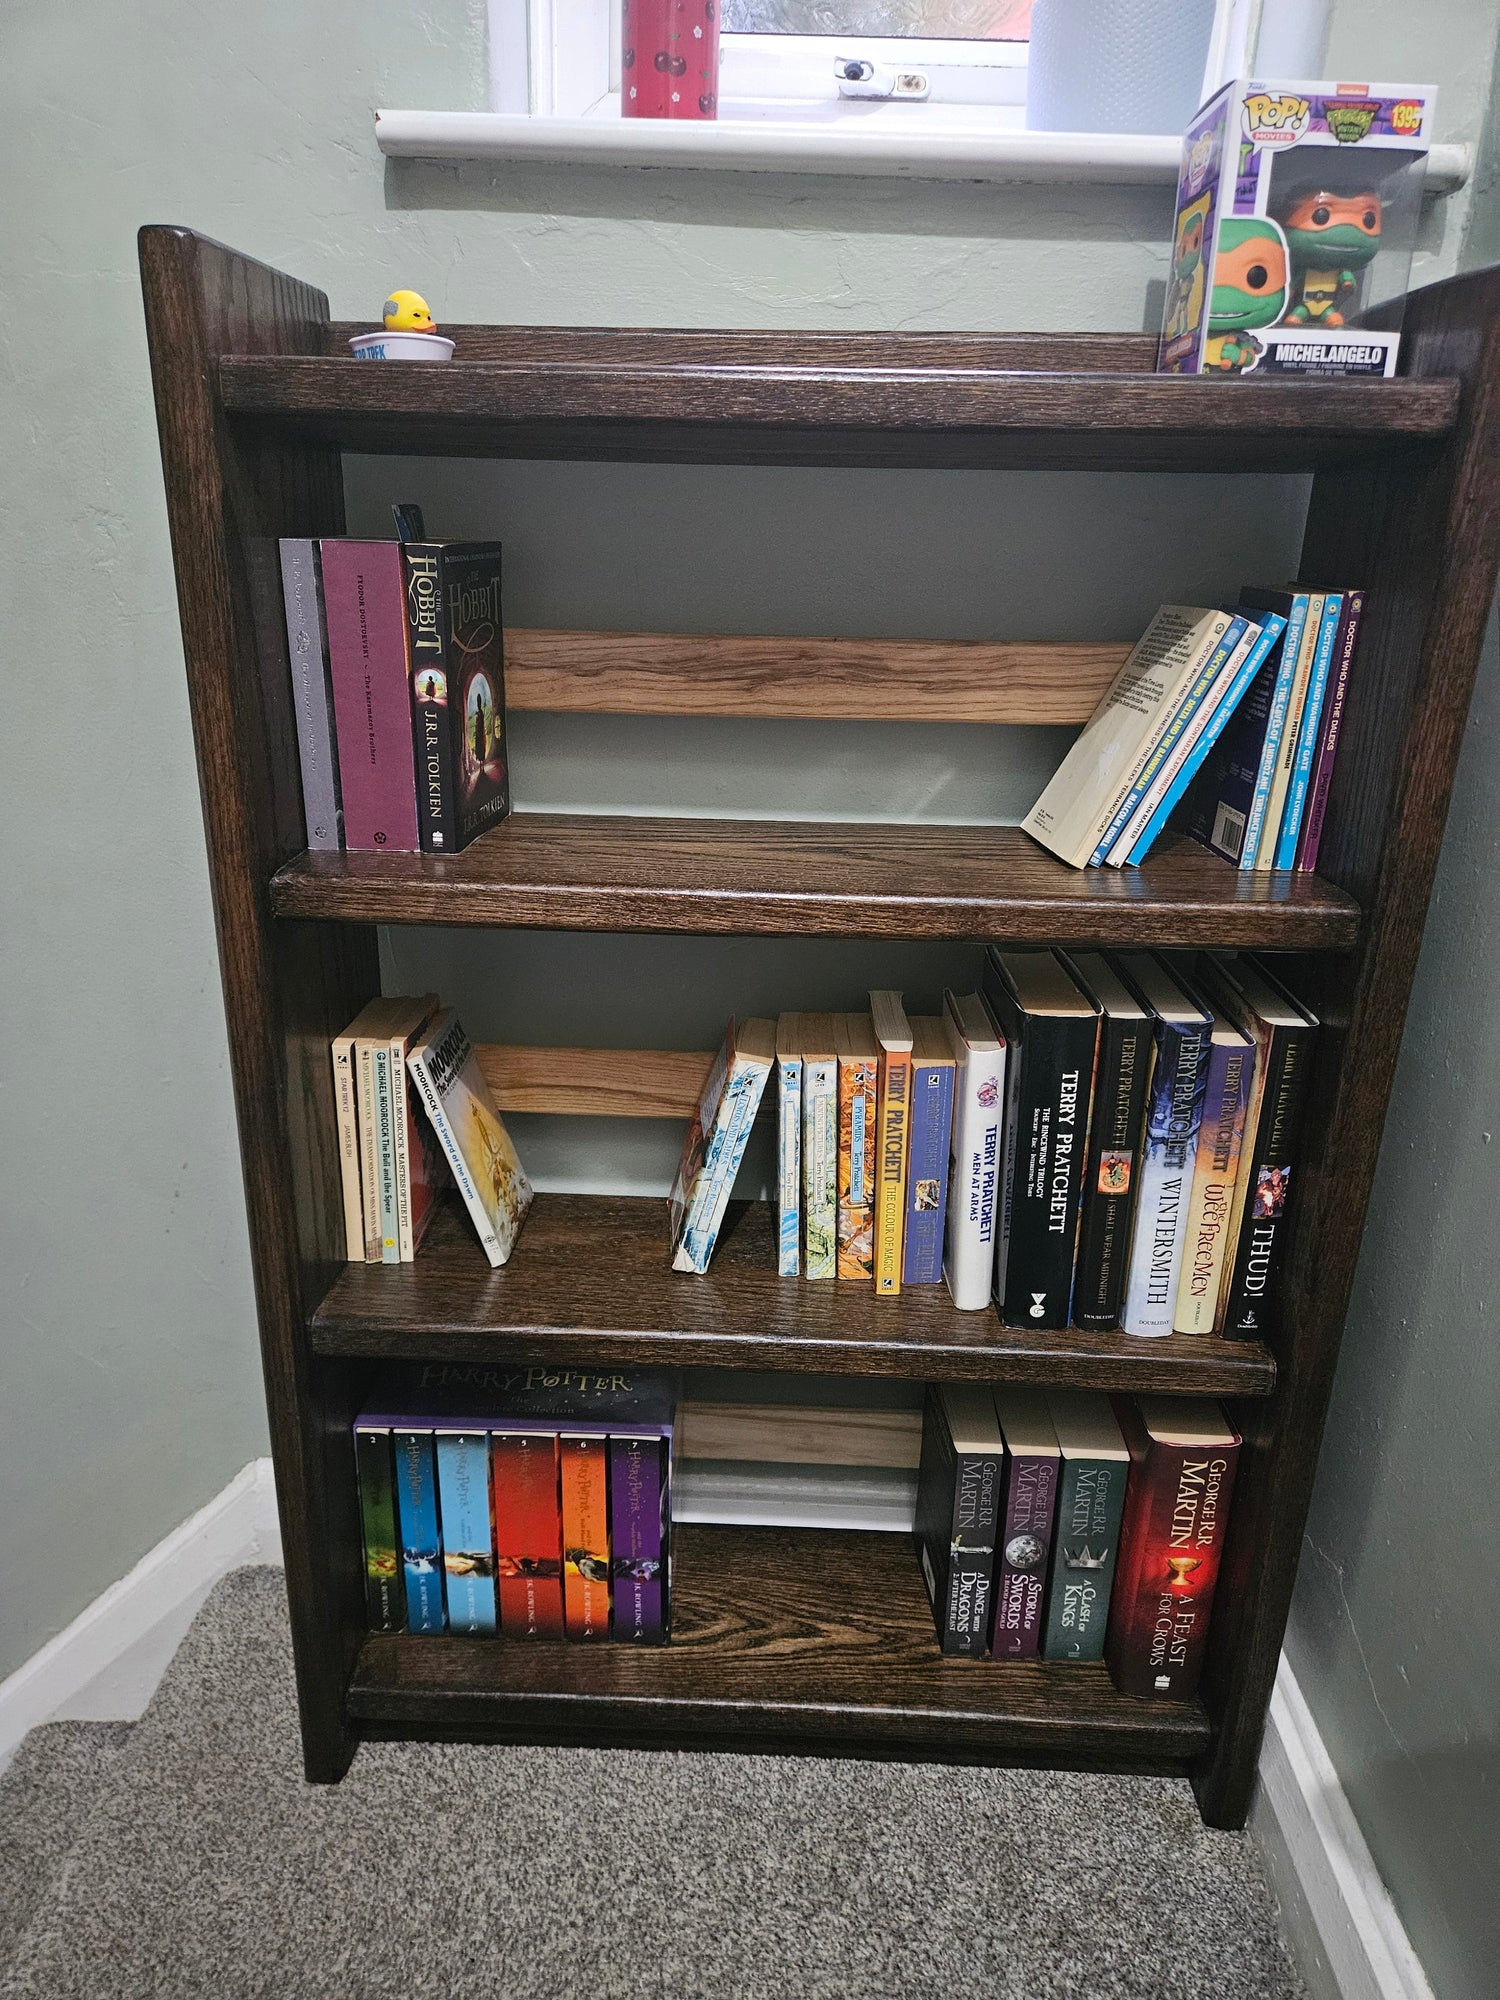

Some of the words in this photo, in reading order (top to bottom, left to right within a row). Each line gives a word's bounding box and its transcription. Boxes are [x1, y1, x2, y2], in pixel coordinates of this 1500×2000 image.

[1243, 94, 1311, 132] POP!
[1392, 104, 1420, 128] 1395
[1275, 344, 1383, 364] MICHELANGELO
[356, 575, 365, 606] FYODOR
[408, 554, 442, 655] HOBBIT
[359, 608, 369, 658] DOSTOEVSKY
[1284, 625, 1301, 659] DOCTOR
[1307, 620, 1318, 644] DOCTOR
[1320, 621, 1333, 657] DOCTOR
[1342, 620, 1357, 657] DOCTOR
[1194, 639, 1214, 668] DOCTOR
[1202, 647, 1227, 680] DOCTOR
[1224, 650, 1245, 679] DOCTOR
[1185, 666, 1198, 683] WHO
[1280, 659, 1294, 679] WHO
[1316, 658, 1327, 680] WHO
[1338, 659, 1349, 680] WHO
[1176, 682, 1188, 698] AND
[1191, 676, 1209, 698] WHO
[1214, 678, 1228, 695] WHO
[1275, 686, 1288, 702] THE
[1312, 681, 1322, 700] AND
[1335, 681, 1345, 700] AND
[365, 690, 373, 730] Karamazov
[1169, 696, 1180, 710] THE
[1177, 697, 1196, 721] DELTA
[1200, 707, 1211, 720] THE
[1206, 694, 1219, 709] AND
[1331, 701, 1342, 718] THE
[424, 710, 439, 752] J.R.R.
[1152, 708, 1173, 738] GENESIS
[1168, 717, 1184, 735] AND
[1289, 720, 1298, 738] PETER
[1303, 700, 1319, 748] WARRIORS'
[1325, 719, 1338, 751] DALEKS
[368, 732, 376, 765] Brothers
[1141, 745, 1152, 758] THE
[1148, 735, 1157, 745] OF
[1159, 732, 1175, 749] THE
[1177, 720, 1203, 757] SONTARAN
[1133, 745, 1166, 792] BANNERMAN
[1283, 739, 1295, 769] GRIMWADE
[1299, 749, 1310, 770] GATE
[1126, 756, 1145, 782] DALEKS
[1154, 755, 1182, 796] EXPERIMENT
[427, 753, 442, 819] TOLKIEN
[1107, 783, 1129, 815] TERRANCE
[1294, 779, 1304, 799] JOHN
[1112, 792, 1138, 827] MALCOLM
[1144, 801, 1155, 814] IAN
[1248, 793, 1265, 830] TERRANCE
[1287, 799, 1300, 835] LYDECKER
[1096, 814, 1111, 834] DICKS
[1098, 824, 1118, 849] KOHLL
[1129, 812, 1148, 840] MARTER
[1243, 829, 1258, 852] DICKS
[1119, 1035, 1136, 1074] TERRY
[1175, 1031, 1203, 1079] TERRY
[377, 1061, 386, 1094] MICHAEL
[394, 1069, 402, 1105] MICHAEL
[413, 1062, 438, 1112] MOORCOCK
[887, 1062, 905, 1103] TERRY
[1222, 1053, 1243, 1095] TERRY
[1057, 1069, 1079, 1125] TERRY
[1111, 1076, 1132, 1146] PRATCHETT
[379, 1096, 389, 1137] MOORCOCK
[395, 1106, 404, 1150] MOORCOCK
[433, 1112, 445, 1128] The
[854, 1106, 862, 1142] PYRAMIDS
[1041, 1107, 1050, 1122] THE
[1162, 1083, 1195, 1169] PRATCHETT
[381, 1139, 389, 1152] The
[440, 1127, 455, 1153] Sword
[883, 1110, 903, 1183] PRATCHETT
[983, 1124, 997, 1165] TERRY
[1038, 1124, 1049, 1165] RINCEWIND
[1211, 1098, 1237, 1172] PRATCHETT
[382, 1153, 390, 1166] Bull
[397, 1152, 405, 1188] MASTERS
[450, 1153, 459, 1163] of
[454, 1162, 465, 1176] the
[853, 1152, 861, 1165] Terry
[972, 1152, 981, 1174] MEN
[383, 1168, 391, 1180] and
[383, 1182, 391, 1193] the
[461, 1177, 474, 1200] Dawn
[971, 1178, 979, 1189] AT
[1035, 1167, 1045, 1198] TRILOGY
[1047, 1132, 1073, 1233] PRATCHETT
[382, 1194, 392, 1213] Spear
[399, 1188, 406, 1197] OF
[886, 1186, 896, 1201] THE
[969, 1192, 979, 1221] ARMS
[978, 1170, 994, 1242] PRATCHETT
[884, 1203, 895, 1234] COLOUR
[1105, 1204, 1115, 1231] SHALL
[884, 1236, 894, 1246] OF
[1102, 1233, 1112, 1258] WEAR
[1145, 1175, 1182, 1306] WINTERSMITH
[883, 1247, 894, 1271] MAGIC
[1242, 1224, 1276, 1298] THUD!
[1097, 1262, 1109, 1304] MIDNIGHT
[521, 1367, 633, 1392] POTTER
[370, 1436, 376, 1444] 2
[409, 1436, 415, 1444] 3
[458, 1437, 464, 1445] 4
[521, 1439, 527, 1447] 5
[580, 1441, 587, 1449] 6
[626, 1451, 642, 1479] HARRY
[958, 1460, 982, 1528] MARTIN
[979, 1461, 997, 1506] GEORGE
[1010, 1462, 1039, 1532] MARTIN
[1034, 1464, 1053, 1509] GEORGE
[1093, 1469, 1111, 1514] GEORGE
[1199, 1458, 1228, 1520] GEORGE
[1070, 1468, 1097, 1537] MARTIN
[1170, 1460, 1209, 1551] MARTIN
[951, 1579, 959, 1599] AFTER
[954, 1571, 977, 1633] DRAGONS
[973, 1579, 989, 1614] DANCE
[1002, 1580, 1010, 1599] BLOOD
[1004, 1573, 1029, 1630] SWORDS
[1022, 1582, 1042, 1620] STORM
[1178, 1594, 1193, 1605] A
[526, 1590, 535, 1622] ROWLING
[582, 1591, 591, 1624] ROWLING
[633, 1593, 642, 1625] ROWLING
[1000, 1600, 1008, 1612] AND
[1058, 1583, 1083, 1628] KINGS
[1077, 1587, 1097, 1623] CLASH
[1157, 1592, 1172, 1616] FOR
[948, 1612, 956, 1631] FEAST
[972, 1615, 980, 1631] WITH
[998, 1612, 1006, 1629] GOLD
[1022, 1620, 1031, 1629] OF
[1077, 1623, 1085, 1631] OF
[1148, 1617, 1173, 1666] CROWS
[1167, 1610, 1195, 1666] FEAST
